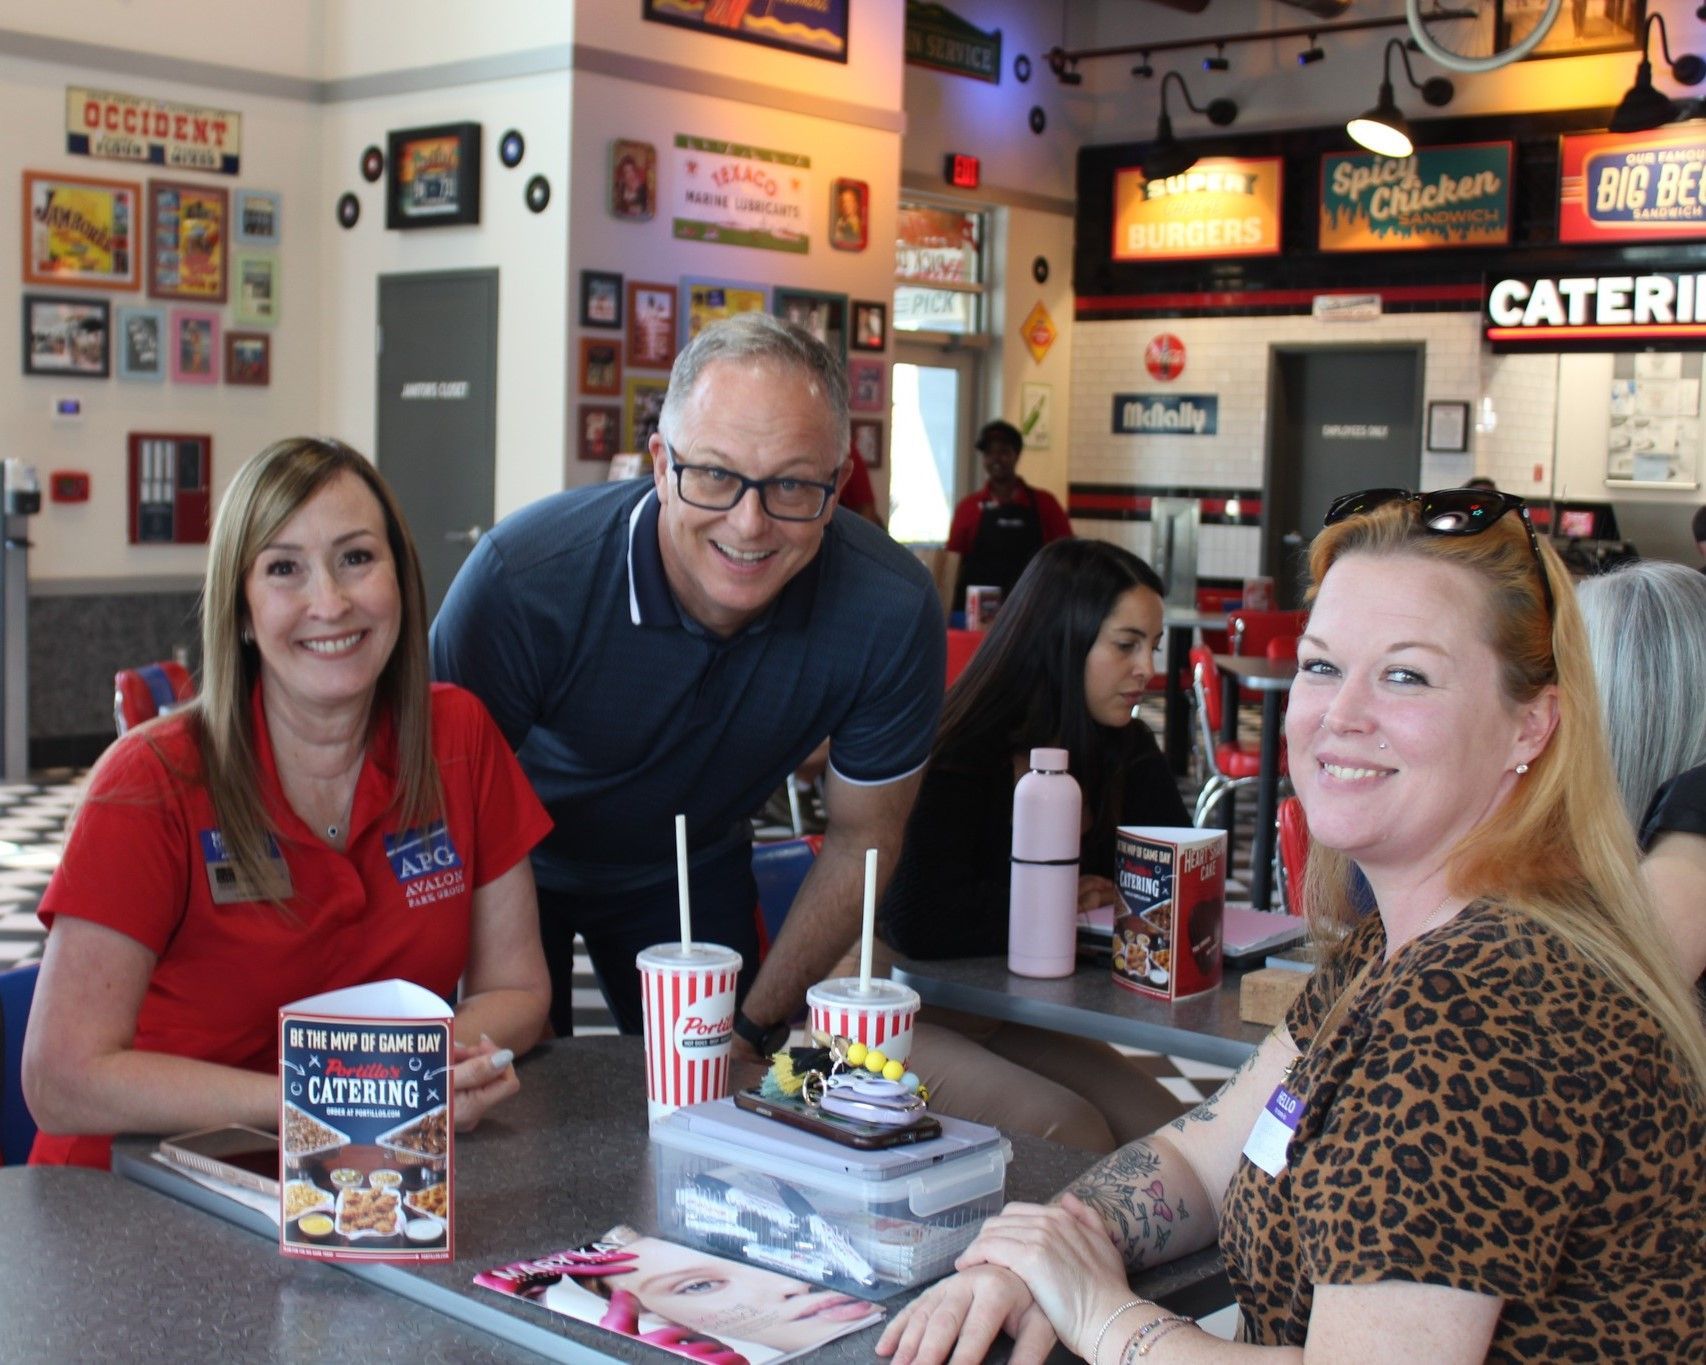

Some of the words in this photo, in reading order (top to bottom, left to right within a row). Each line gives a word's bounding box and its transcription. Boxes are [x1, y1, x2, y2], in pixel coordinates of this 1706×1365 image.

[84, 101, 227, 146] OCCIDENT
[1625, 152, 1655, 166] OUR
[1657, 148, 1706, 164] FAMOU
[711, 163, 777, 197] TEXACO
[1147, 172, 1247, 199] SUPER
[1332, 156, 1421, 202] Spicy
[1596, 164, 1650, 212] BIG
[685, 189, 729, 208] MARINE
[734, 197, 799, 218] LUBRICANTS
[1370, 170, 1500, 220] Chicken
[1399, 208, 1499, 225] SANDWICH
[1633, 205, 1703, 219] SANDWICH
[1128, 216, 1263, 250] BURGERS
[1123, 401, 1206, 433] McNally
[400, 846, 456, 879] APG
[1143, 847, 1159, 861] GAME
[1159, 850, 1172, 864] DAY
[1184, 846, 1210, 873] HEART
[405, 870, 463, 898] AVALON
[1119, 870, 1160, 898] CATERING
[408, 893, 436, 908] PARK
[290, 1028, 304, 1048] BE
[306, 1029, 327, 1050] THE
[331, 1032, 357, 1052] MVP
[361, 1033, 375, 1052] OF
[379, 1034, 414, 1053] GAME
[417, 1034, 441, 1053] DAY
[325, 1058, 401, 1079] Portillo's
[308, 1076, 418, 1108] CATERING
[1276, 1089, 1297, 1114] HELLO
